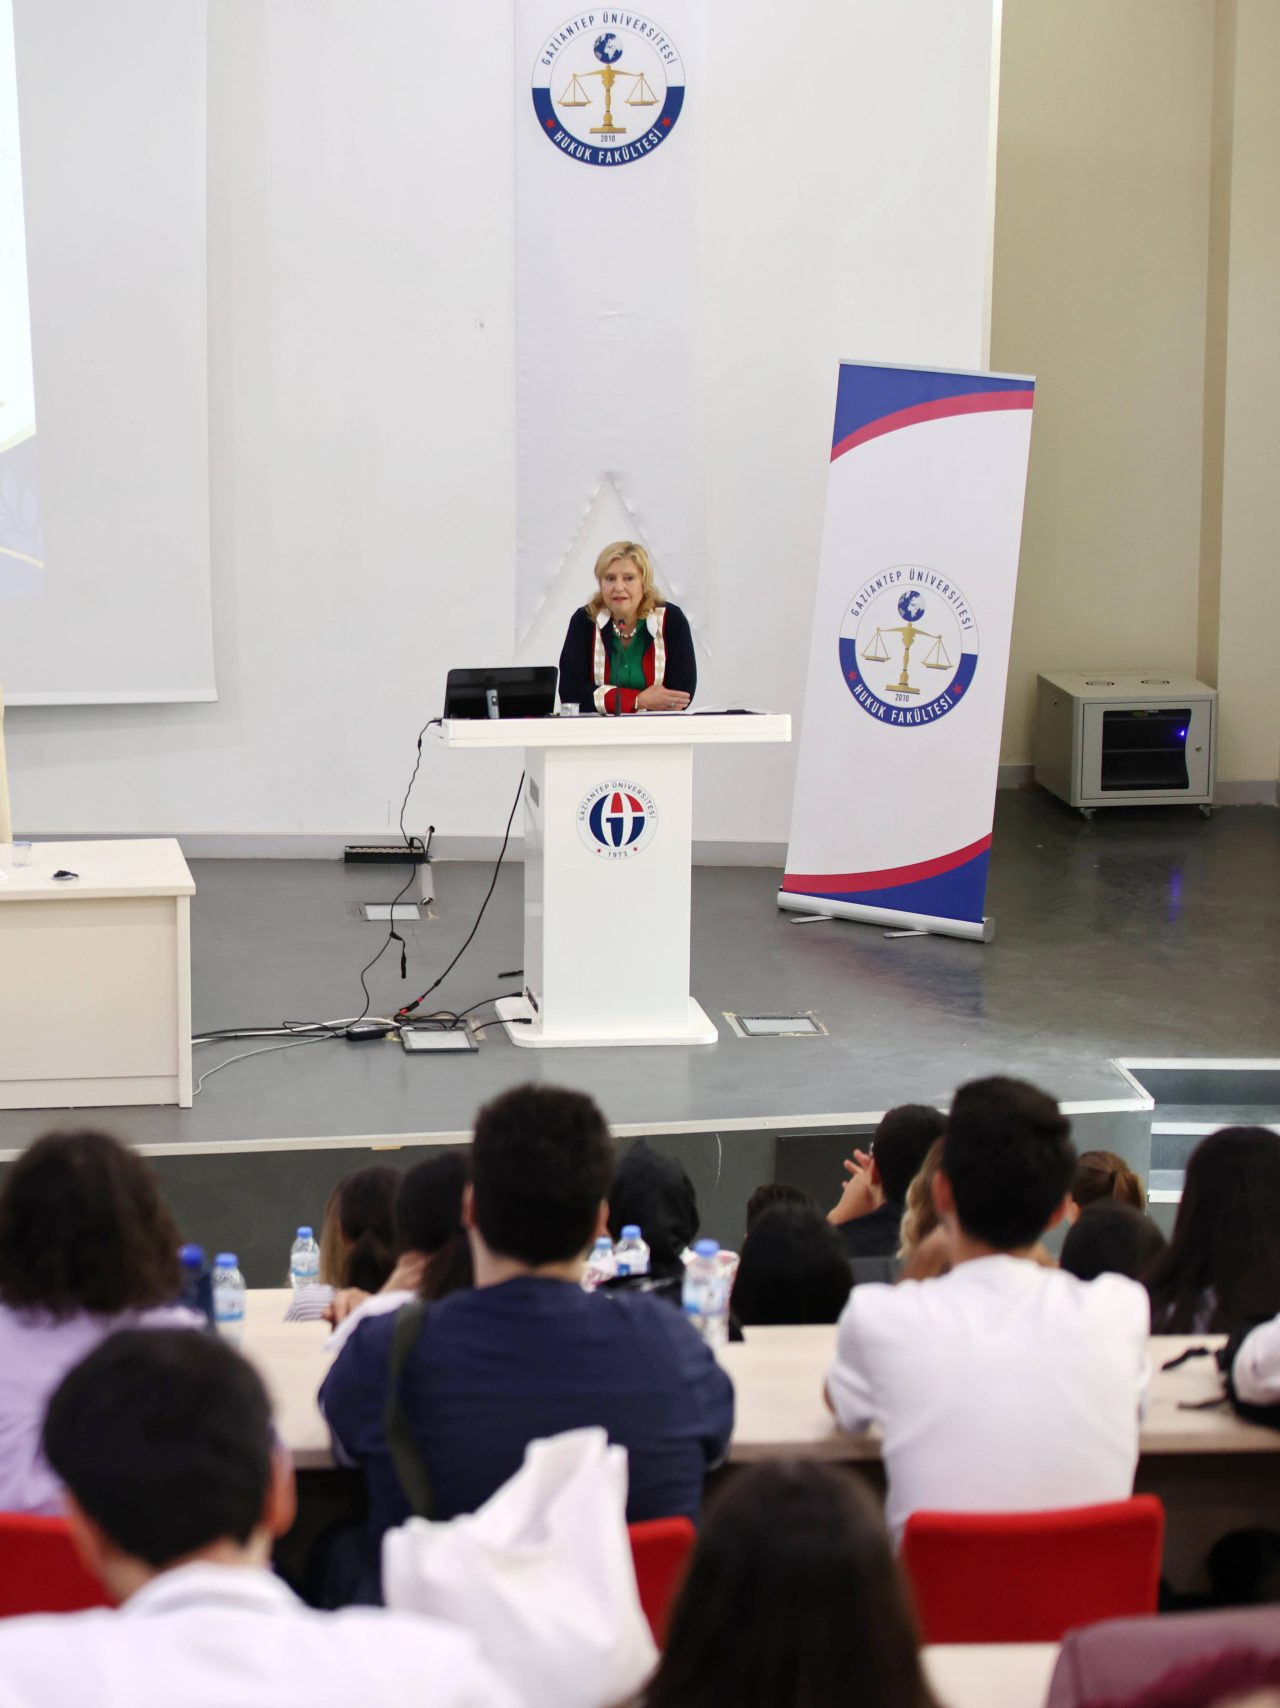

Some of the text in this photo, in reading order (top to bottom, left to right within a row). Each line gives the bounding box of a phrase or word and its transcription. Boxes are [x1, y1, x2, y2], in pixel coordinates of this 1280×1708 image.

[541, 11, 678, 66] GAZİANTEP ÜNİVERSİTESİ
[553, 128, 663, 164] HUKUK FAKÜLTESİ
[851, 568, 974, 630] GAZİANTEP ÜNİVERSİTESİ
[853, 683, 953, 724] HUKUK FAKÜLTESİ
